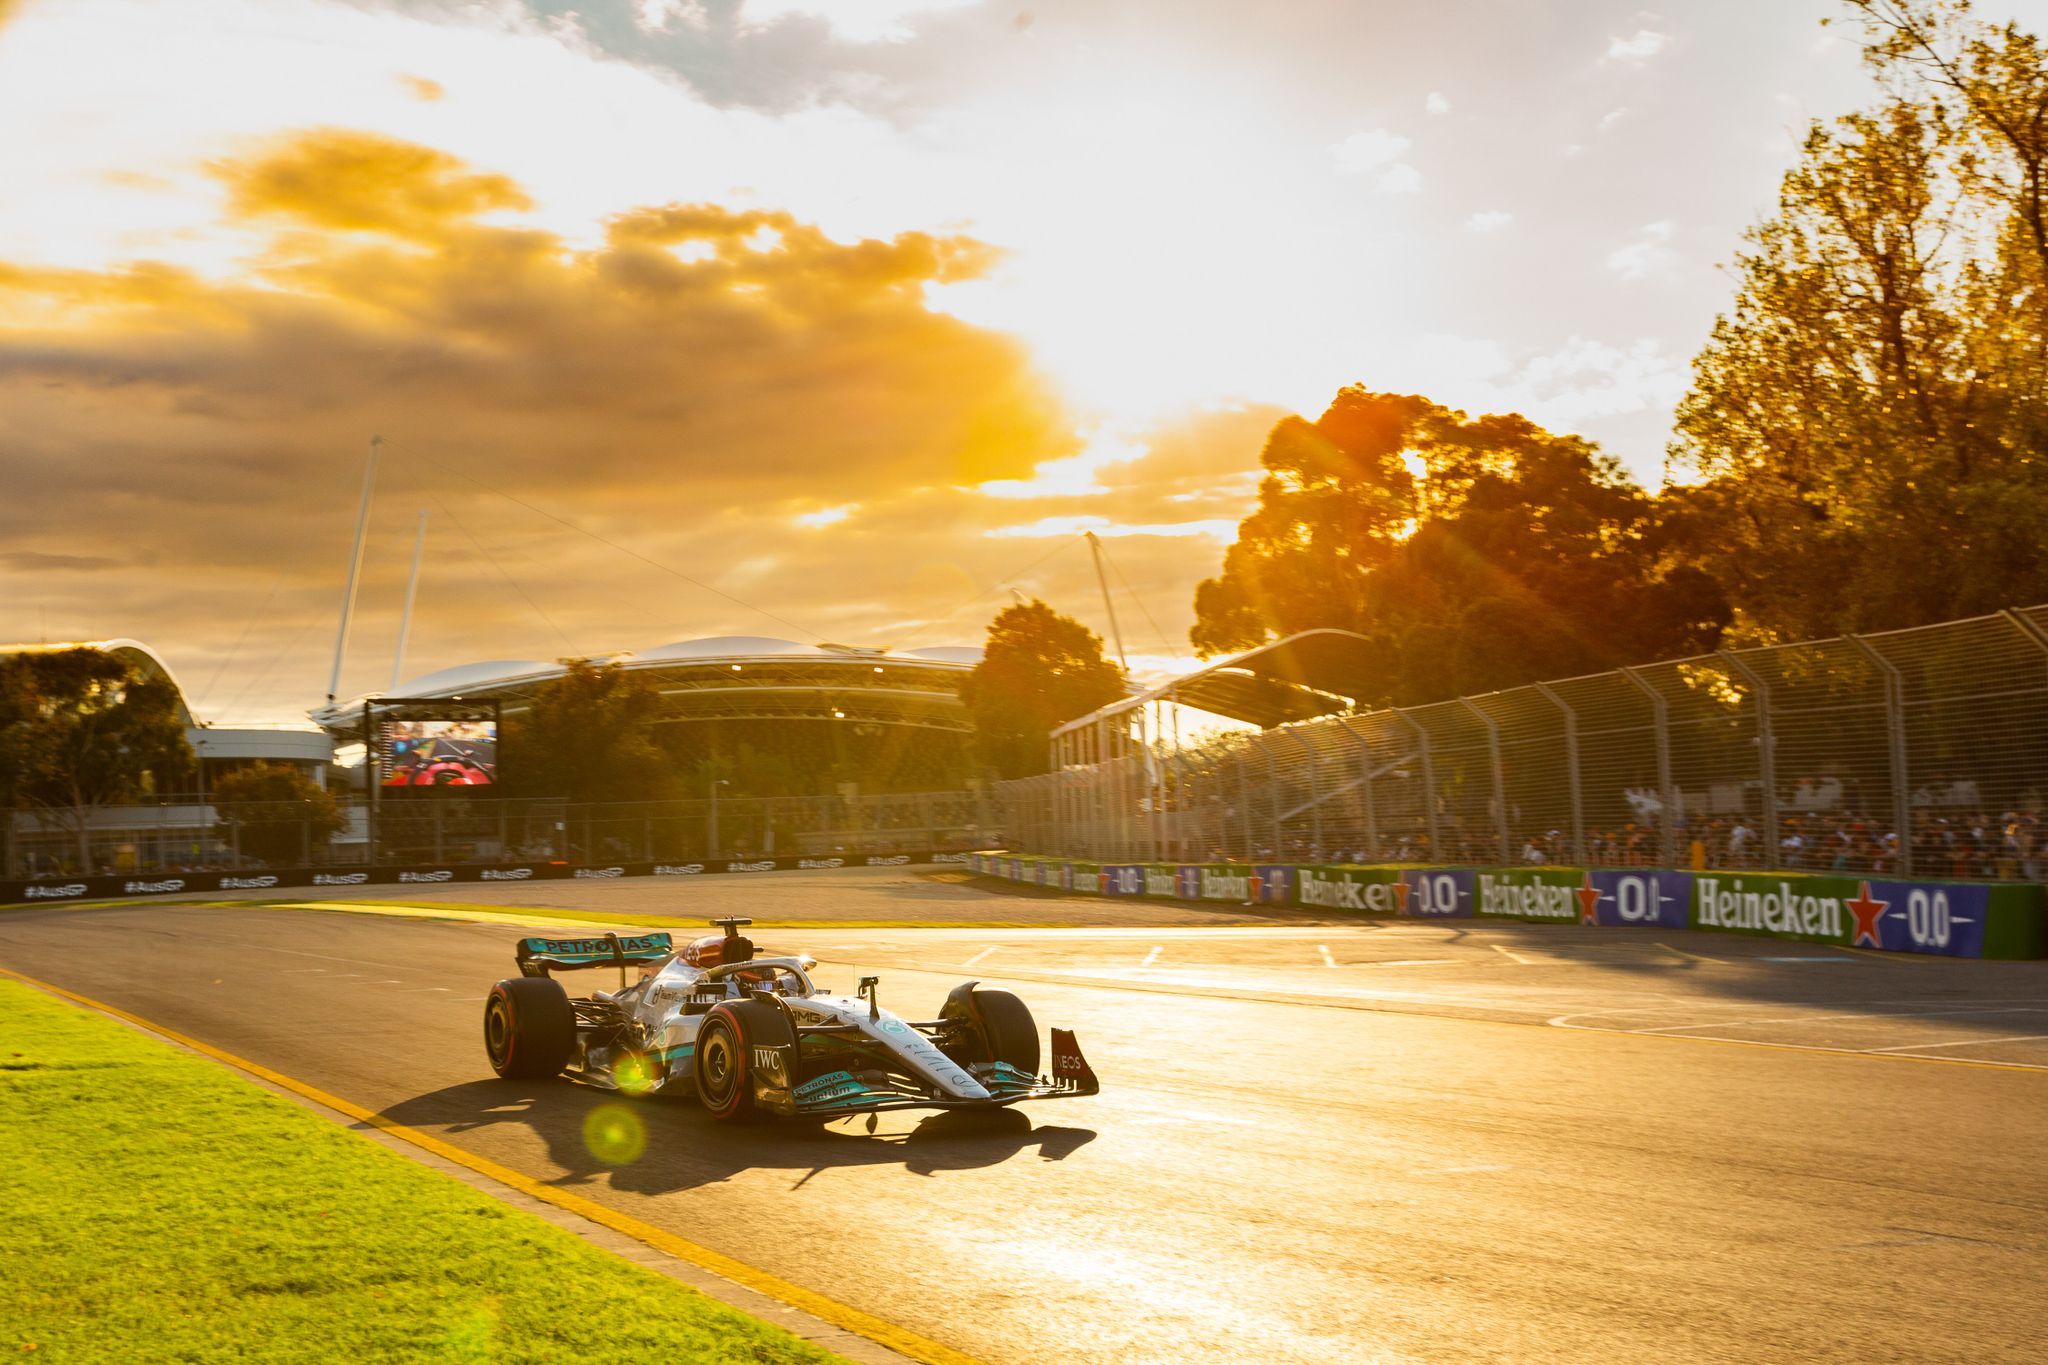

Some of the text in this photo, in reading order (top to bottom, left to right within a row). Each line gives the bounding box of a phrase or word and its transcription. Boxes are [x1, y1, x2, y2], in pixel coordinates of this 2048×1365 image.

[219, 876, 279, 889] #AusGP
[313, 873, 369, 885] #AusGP
[398, 871, 454, 883] #AusGP
[24, 884, 88, 898] #AusGP
[125, 880, 186, 893] #AusGP
[1418, 875, 1457, 914] 0.0
[1479, 874, 1661, 921] Heineken 0.0
[1696, 878, 1951, 948] Heineken 0.0
[754, 1049, 780, 1070] IWC
[1054, 1054, 1081, 1070] INEOS
[794, 1072, 844, 1095] PETRONAS
